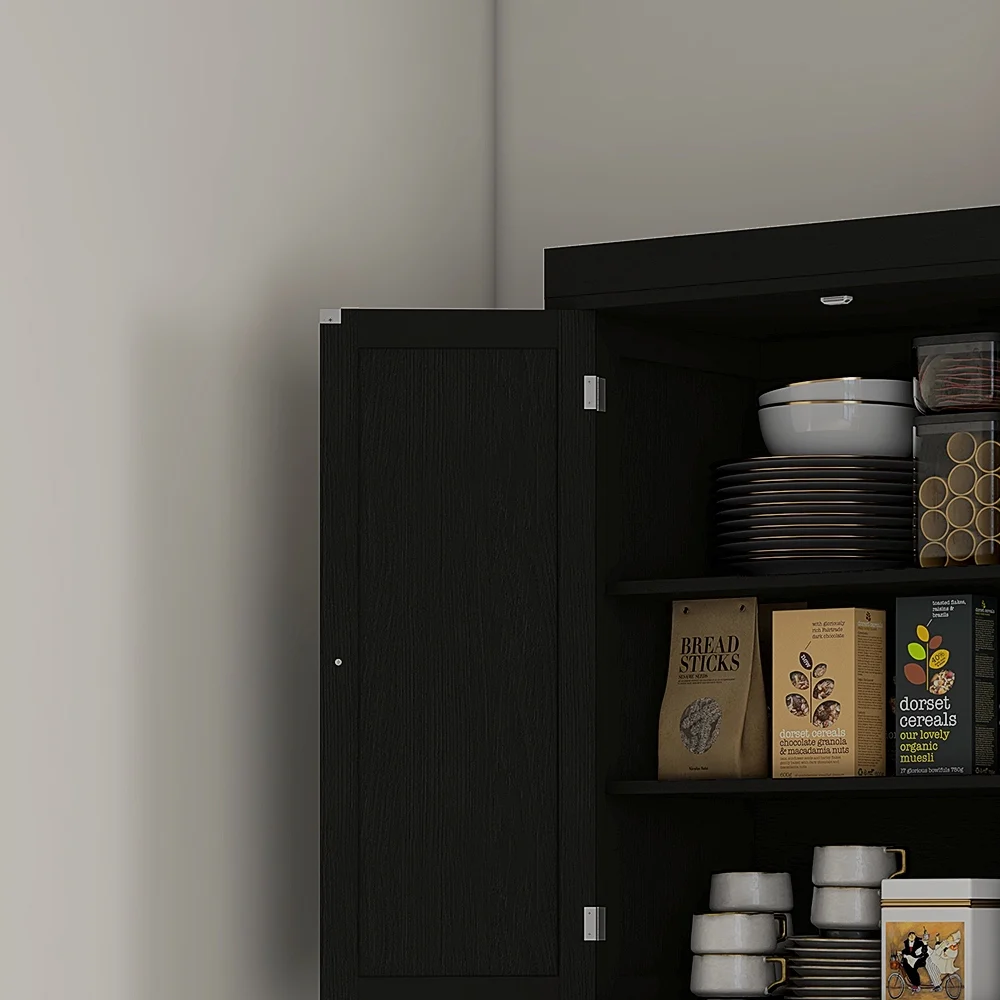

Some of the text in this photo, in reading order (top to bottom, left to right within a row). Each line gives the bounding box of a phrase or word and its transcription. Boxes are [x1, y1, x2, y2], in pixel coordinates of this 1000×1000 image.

[680, 634, 740, 655] BREAD
[679, 653, 740, 673] STICKS
[900, 695, 951, 711] dorset
[900, 711, 957, 728] cereals
[779, 727, 846, 739] dorset cereals
[900, 732, 918, 740] our
[919, 729, 950, 741] lovely
[779, 737, 848, 747] chocolate granola
[900, 741, 939, 753] organic
[787, 747, 831, 755] macadamia
[832, 746, 850, 754] nuts
[900, 752, 934, 763] muesli
